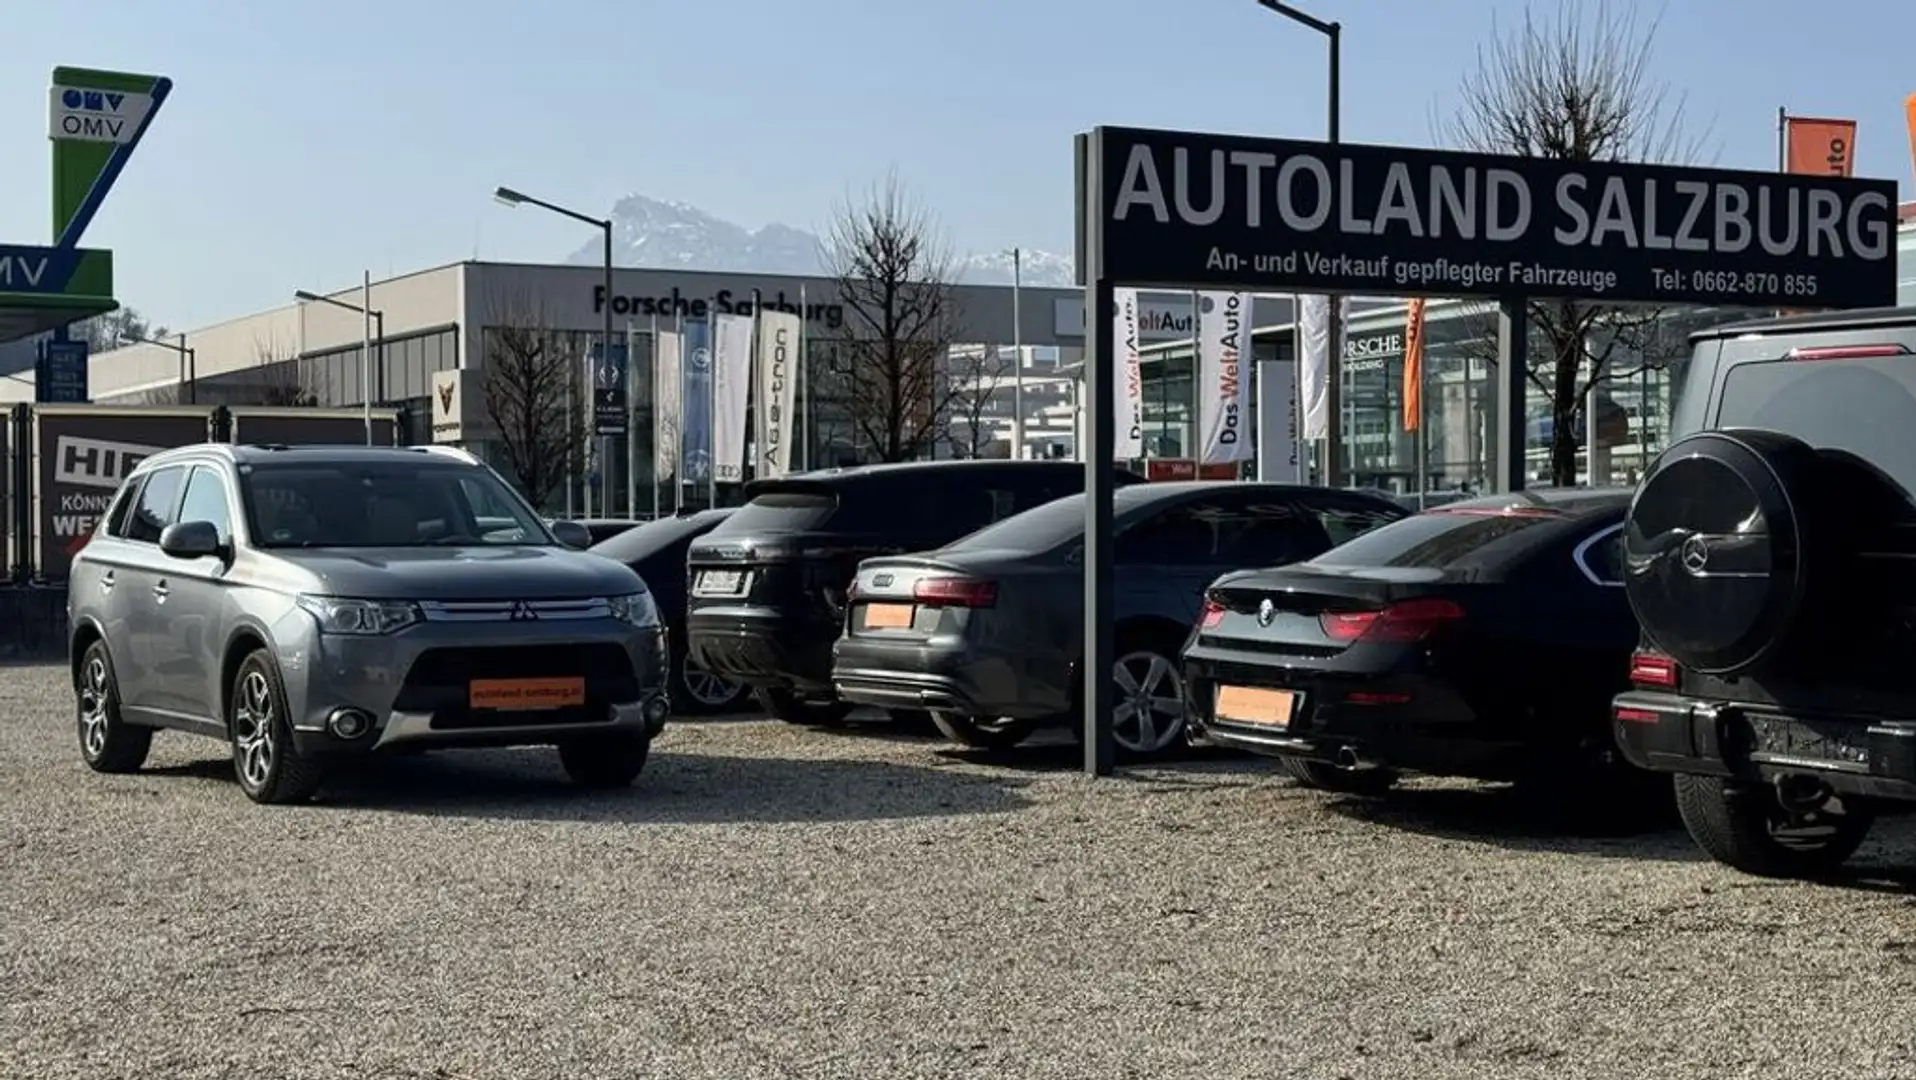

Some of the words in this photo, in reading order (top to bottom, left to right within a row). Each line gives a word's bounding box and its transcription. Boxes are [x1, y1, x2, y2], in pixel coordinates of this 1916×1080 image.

[62, 116, 124, 137] OMV
[1113, 143, 1533, 242] AUTOLAND
[1553, 172, 1889, 261] SALZBURG
[1206, 246, 1248, 270] An-
[1254, 251, 1297, 273] und
[1304, 251, 1390, 278] Verkauf
[1394, 257, 1504, 288] gepflegter
[1509, 261, 1618, 292] Fahrzeuge
[1651, 268, 1687, 291] Tel:
[1693, 270, 1779, 294] 0662-870
[1784, 275, 1818, 296] 855
[1219, 403, 1239, 444] Das
